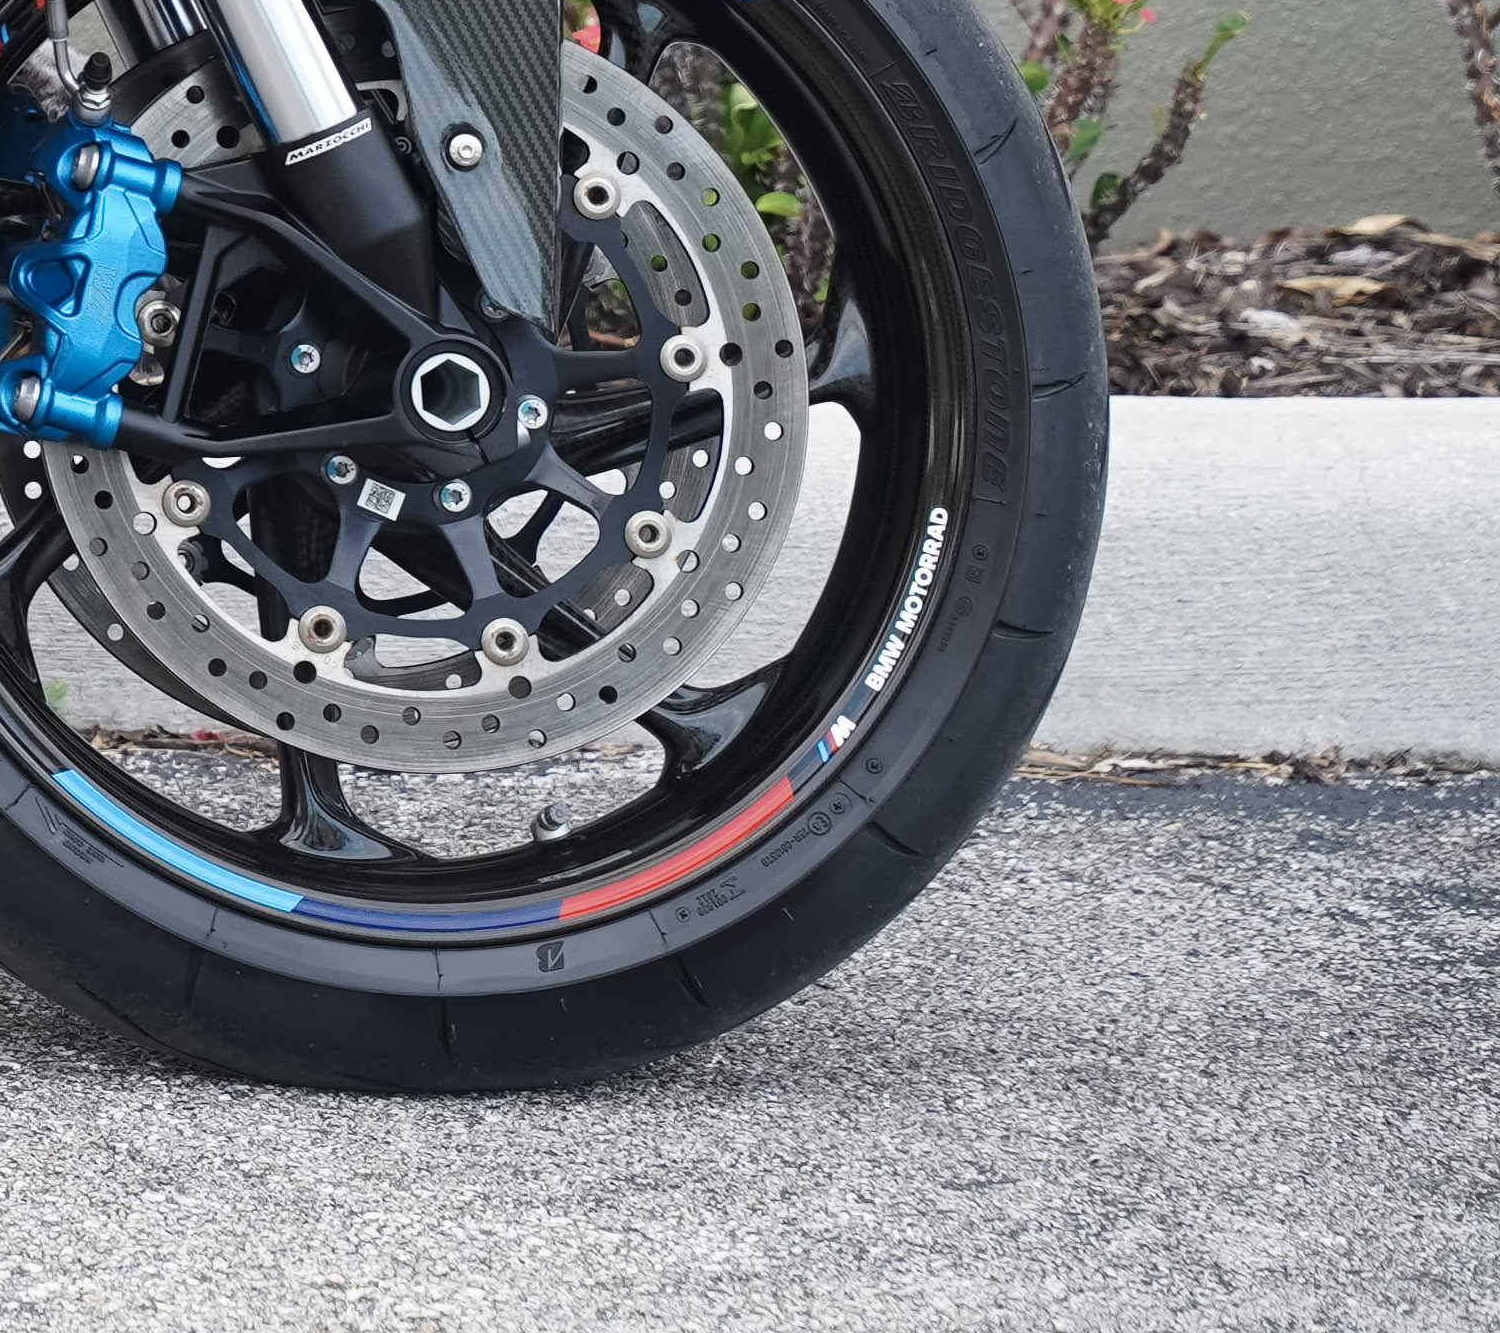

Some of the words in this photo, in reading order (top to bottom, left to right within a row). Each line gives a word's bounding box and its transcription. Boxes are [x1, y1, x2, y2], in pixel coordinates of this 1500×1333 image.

[883, 80, 1008, 487] BRIDGESTONE
[865, 637, 905, 692] BMW
[895, 506, 949, 634] MOTORRAD
